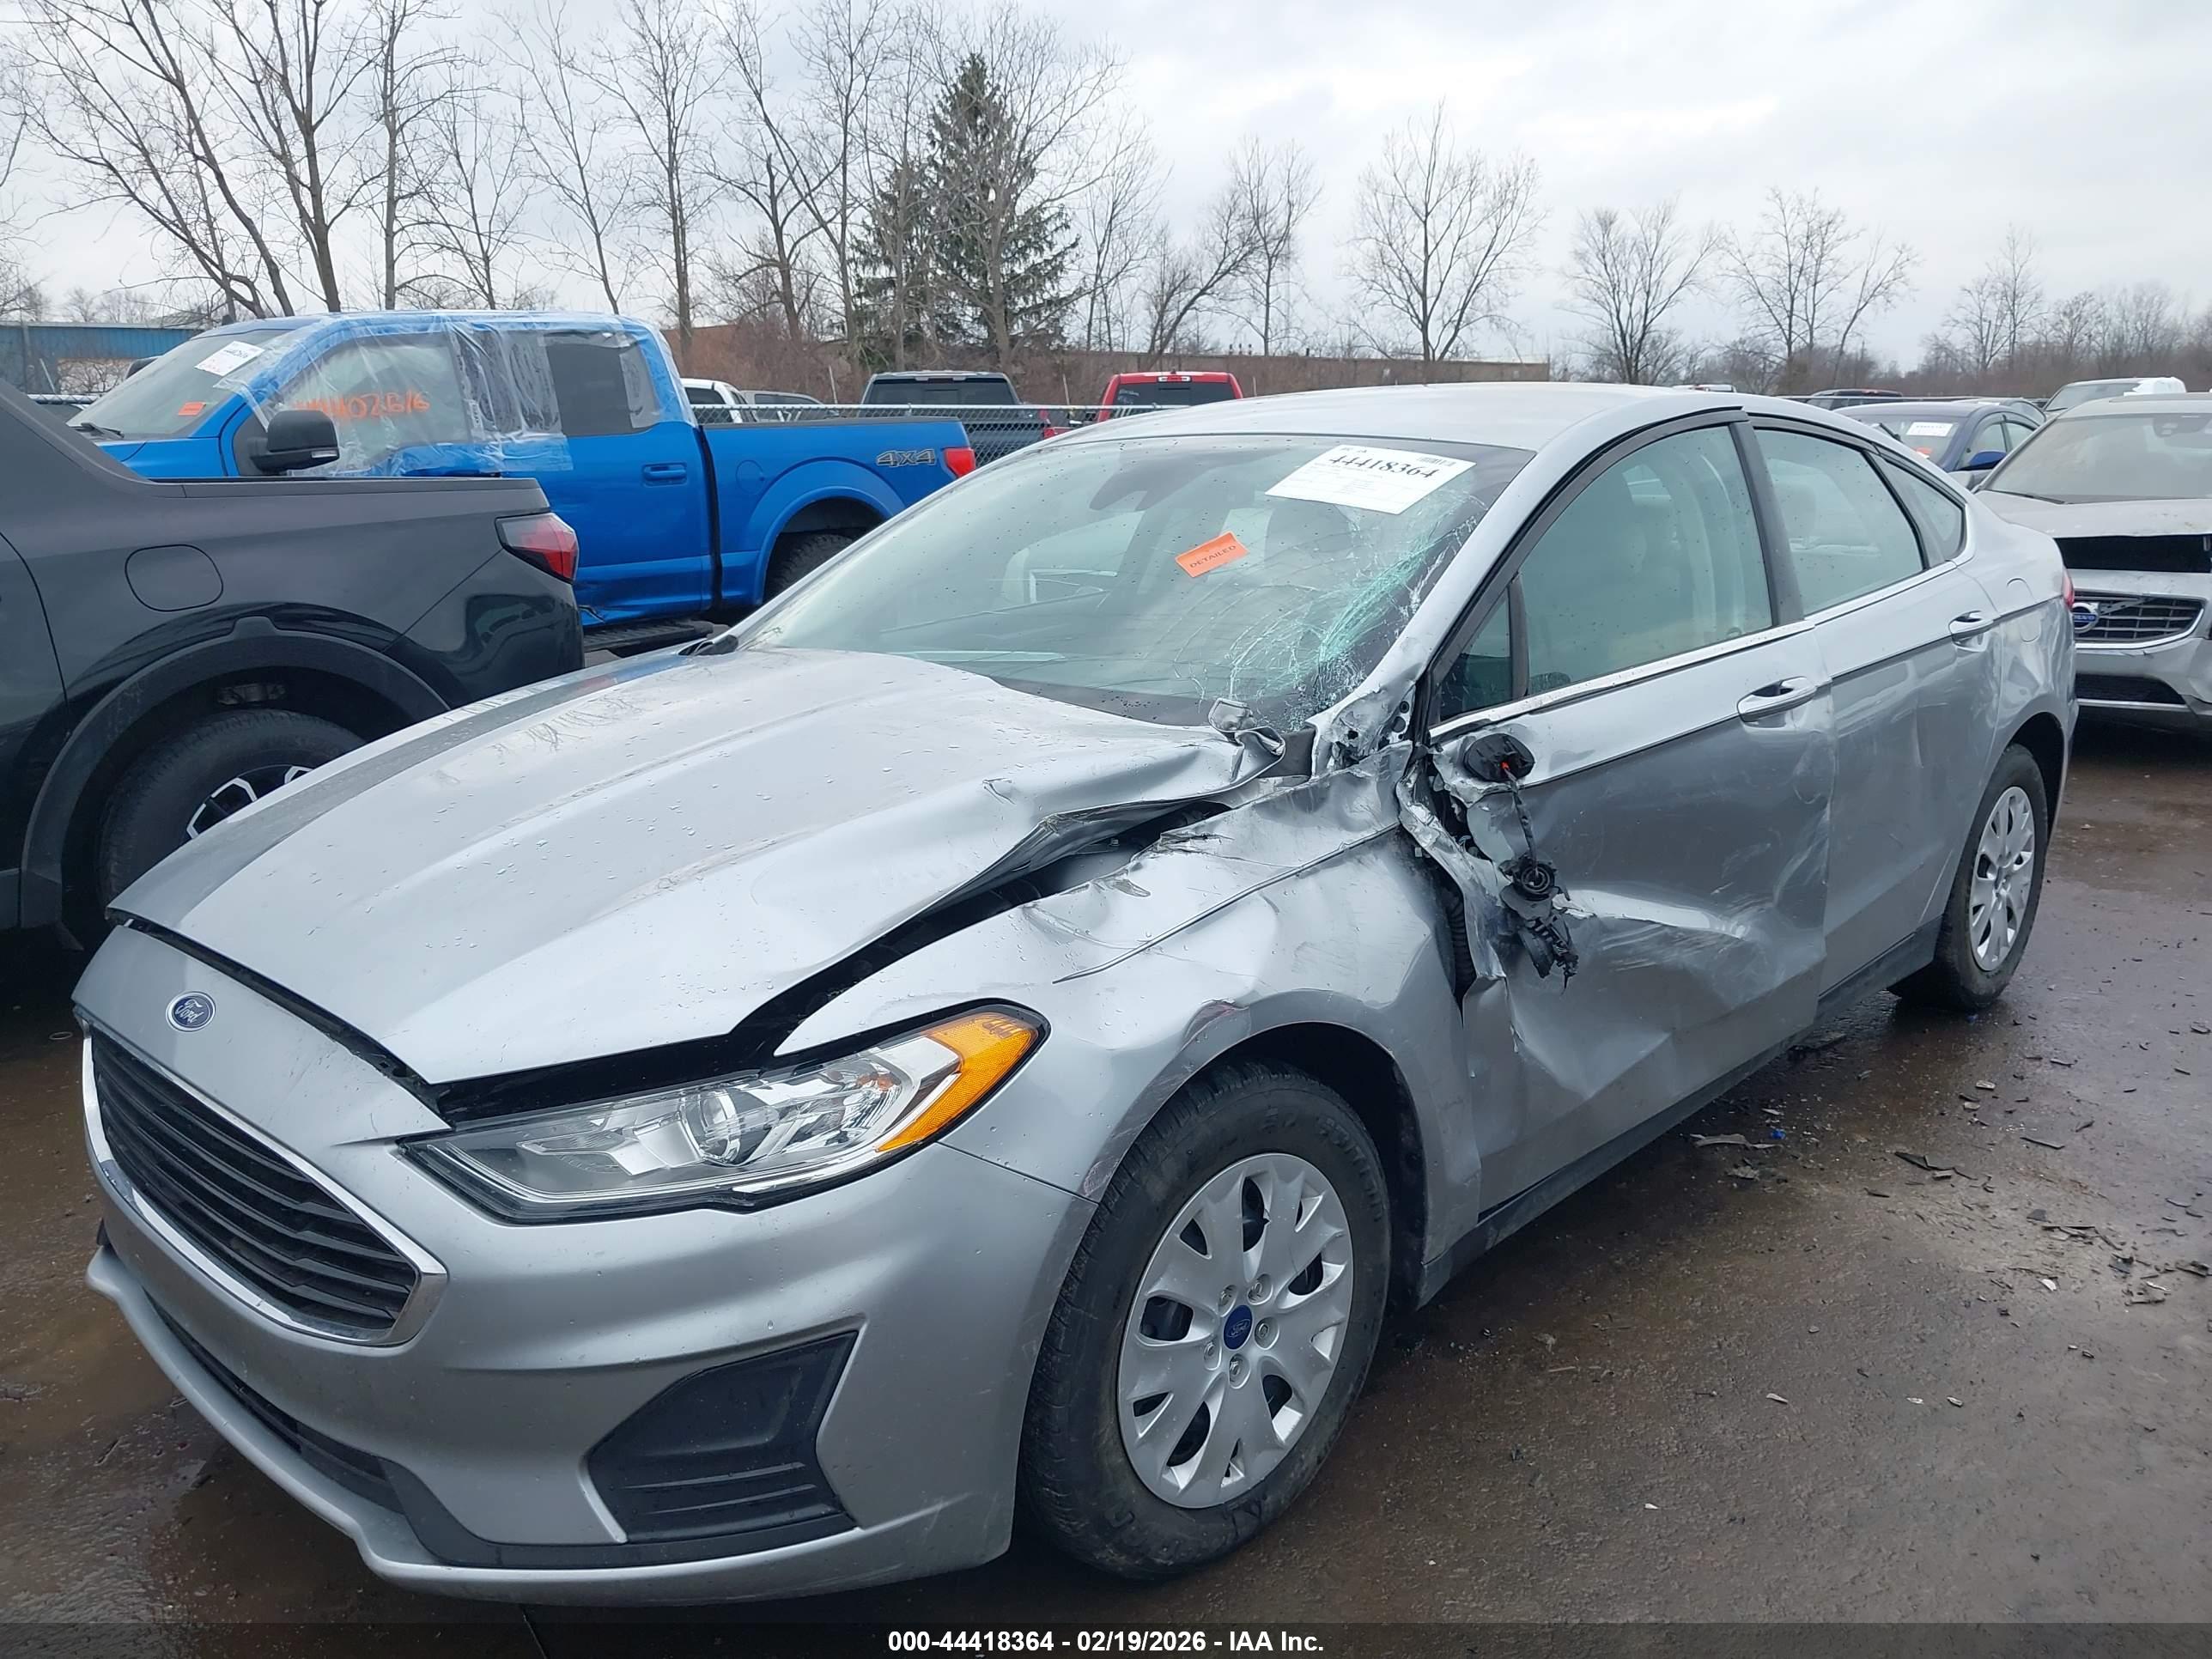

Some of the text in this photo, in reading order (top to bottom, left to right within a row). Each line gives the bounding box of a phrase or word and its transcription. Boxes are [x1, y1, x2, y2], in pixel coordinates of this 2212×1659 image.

[1328, 454, 1440, 478] 44418364
[1188, 544, 1237, 568] DETAILED
[174, 998, 205, 1024] Ford
